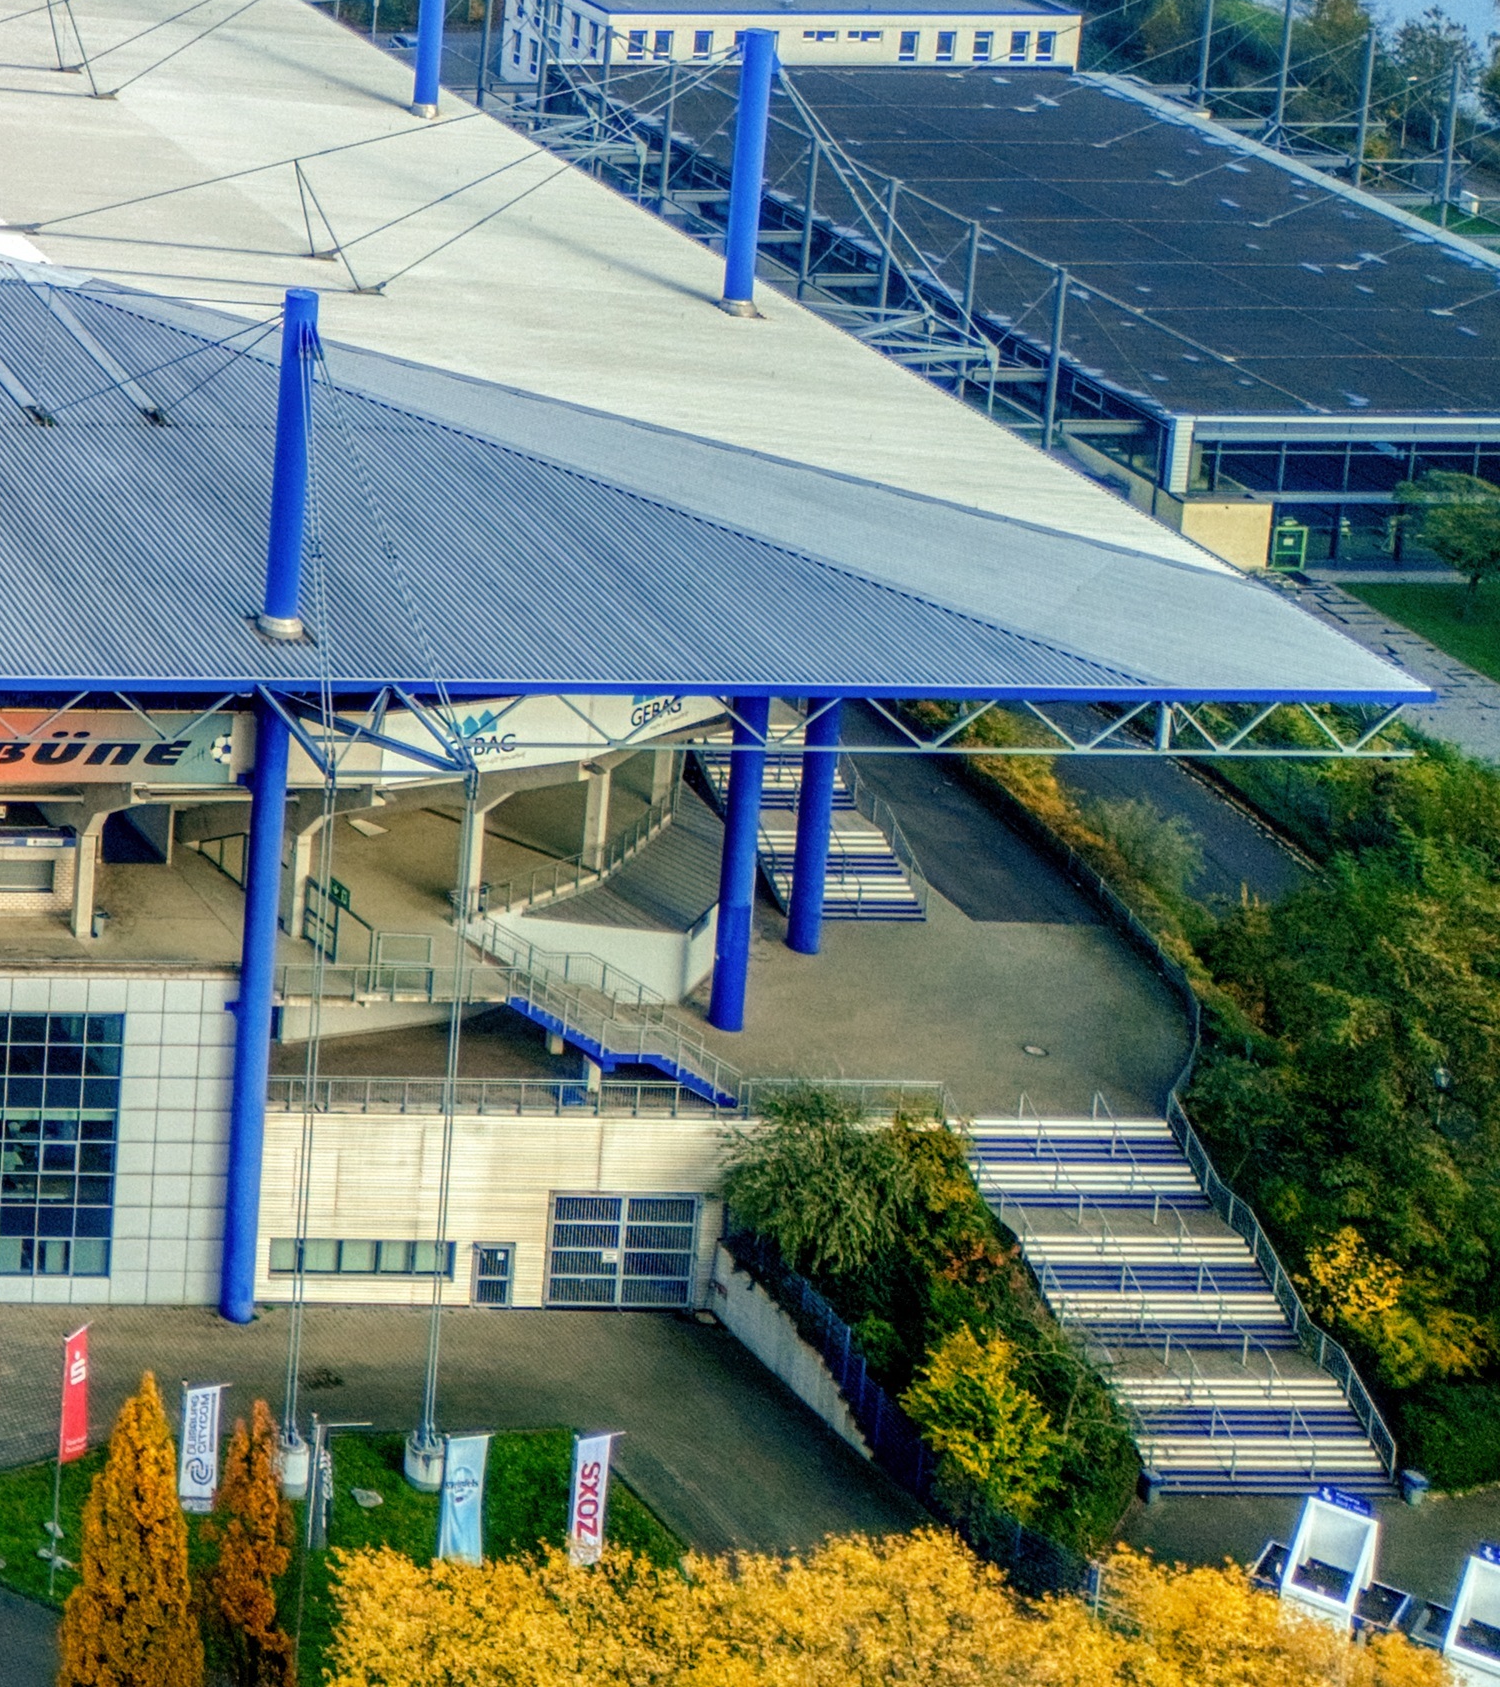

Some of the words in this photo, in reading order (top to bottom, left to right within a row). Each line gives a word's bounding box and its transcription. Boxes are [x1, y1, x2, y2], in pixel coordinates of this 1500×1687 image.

[630, 699, 682, 727] GEBAG
[199, 1393, 211, 1455] CITYCOM
[576, 1461, 601, 1540] ZOXS
